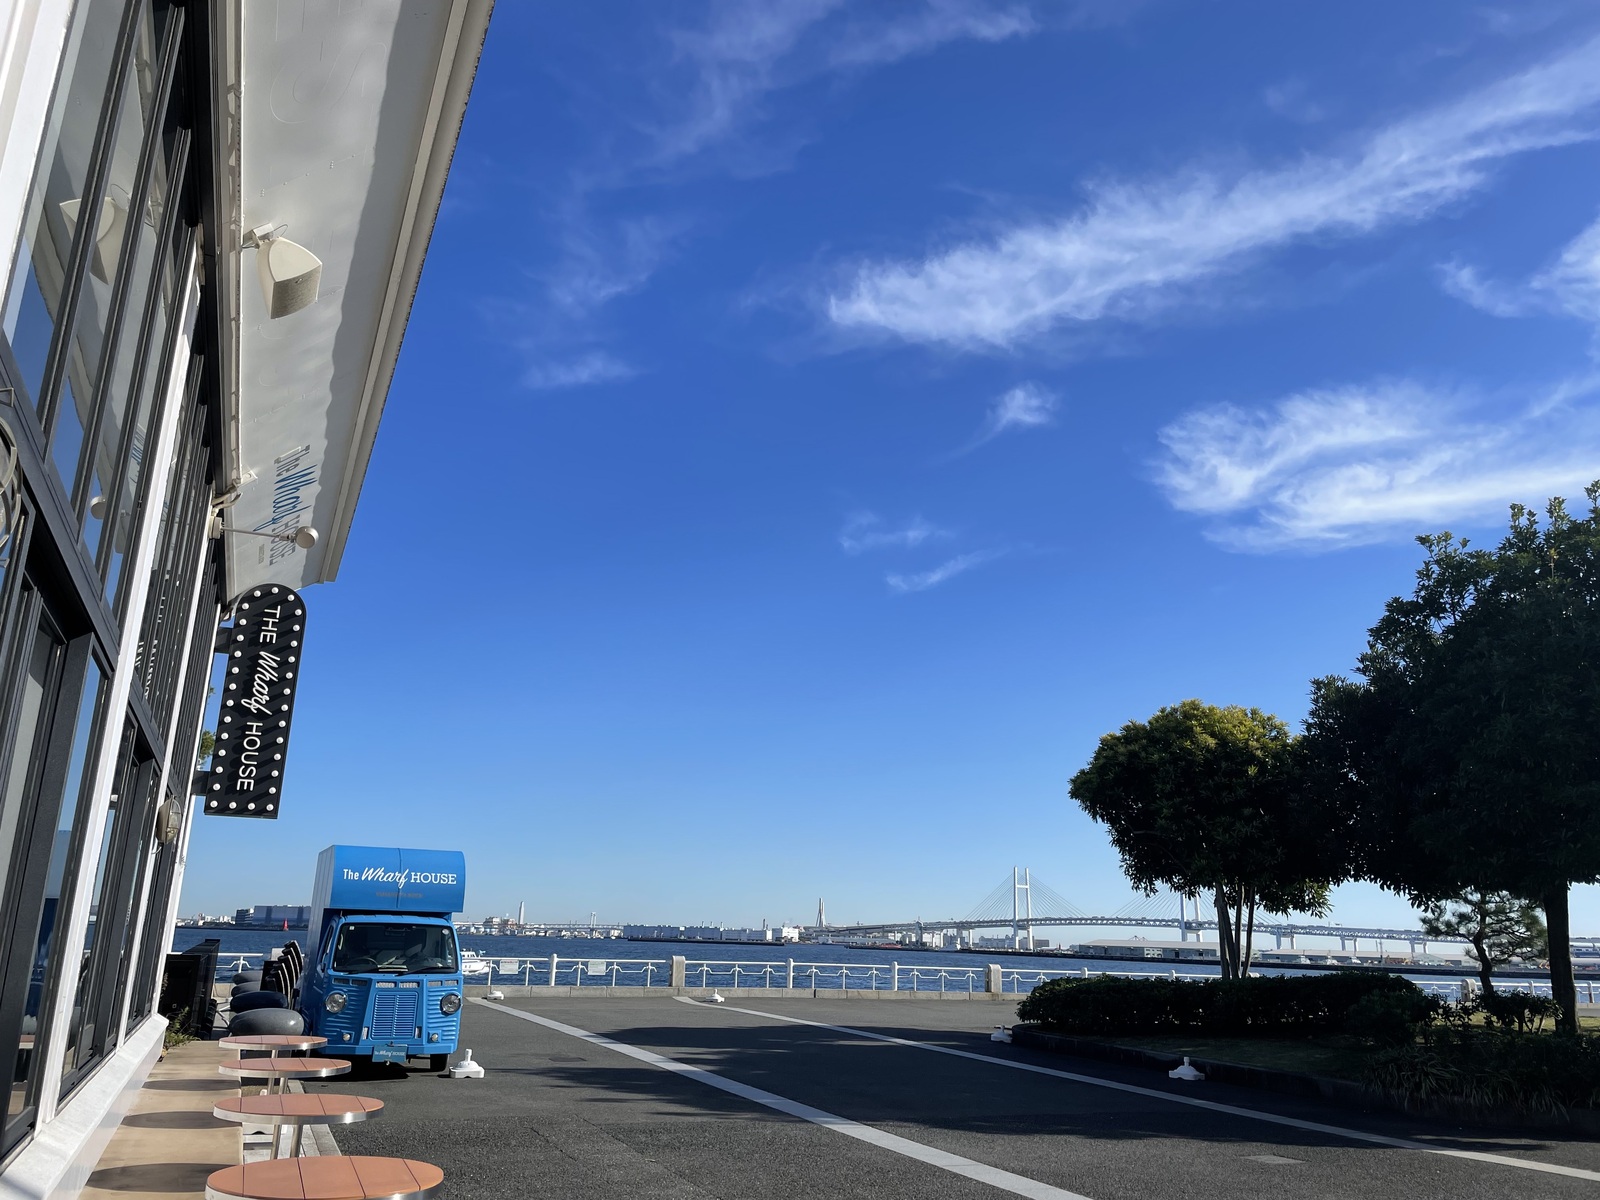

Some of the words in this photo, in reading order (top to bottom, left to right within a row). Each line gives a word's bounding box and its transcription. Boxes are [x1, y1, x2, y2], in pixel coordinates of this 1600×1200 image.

[274, 444, 310, 477] The
[253, 464, 318, 532] Wharf
[259, 605, 281, 644] THE
[241, 651, 281, 715] Wharf
[236, 722, 264, 791] HOUSE
[343, 868, 359, 881] The
[361, 866, 410, 889] Wharf
[410, 872, 457, 885] HOUSE
